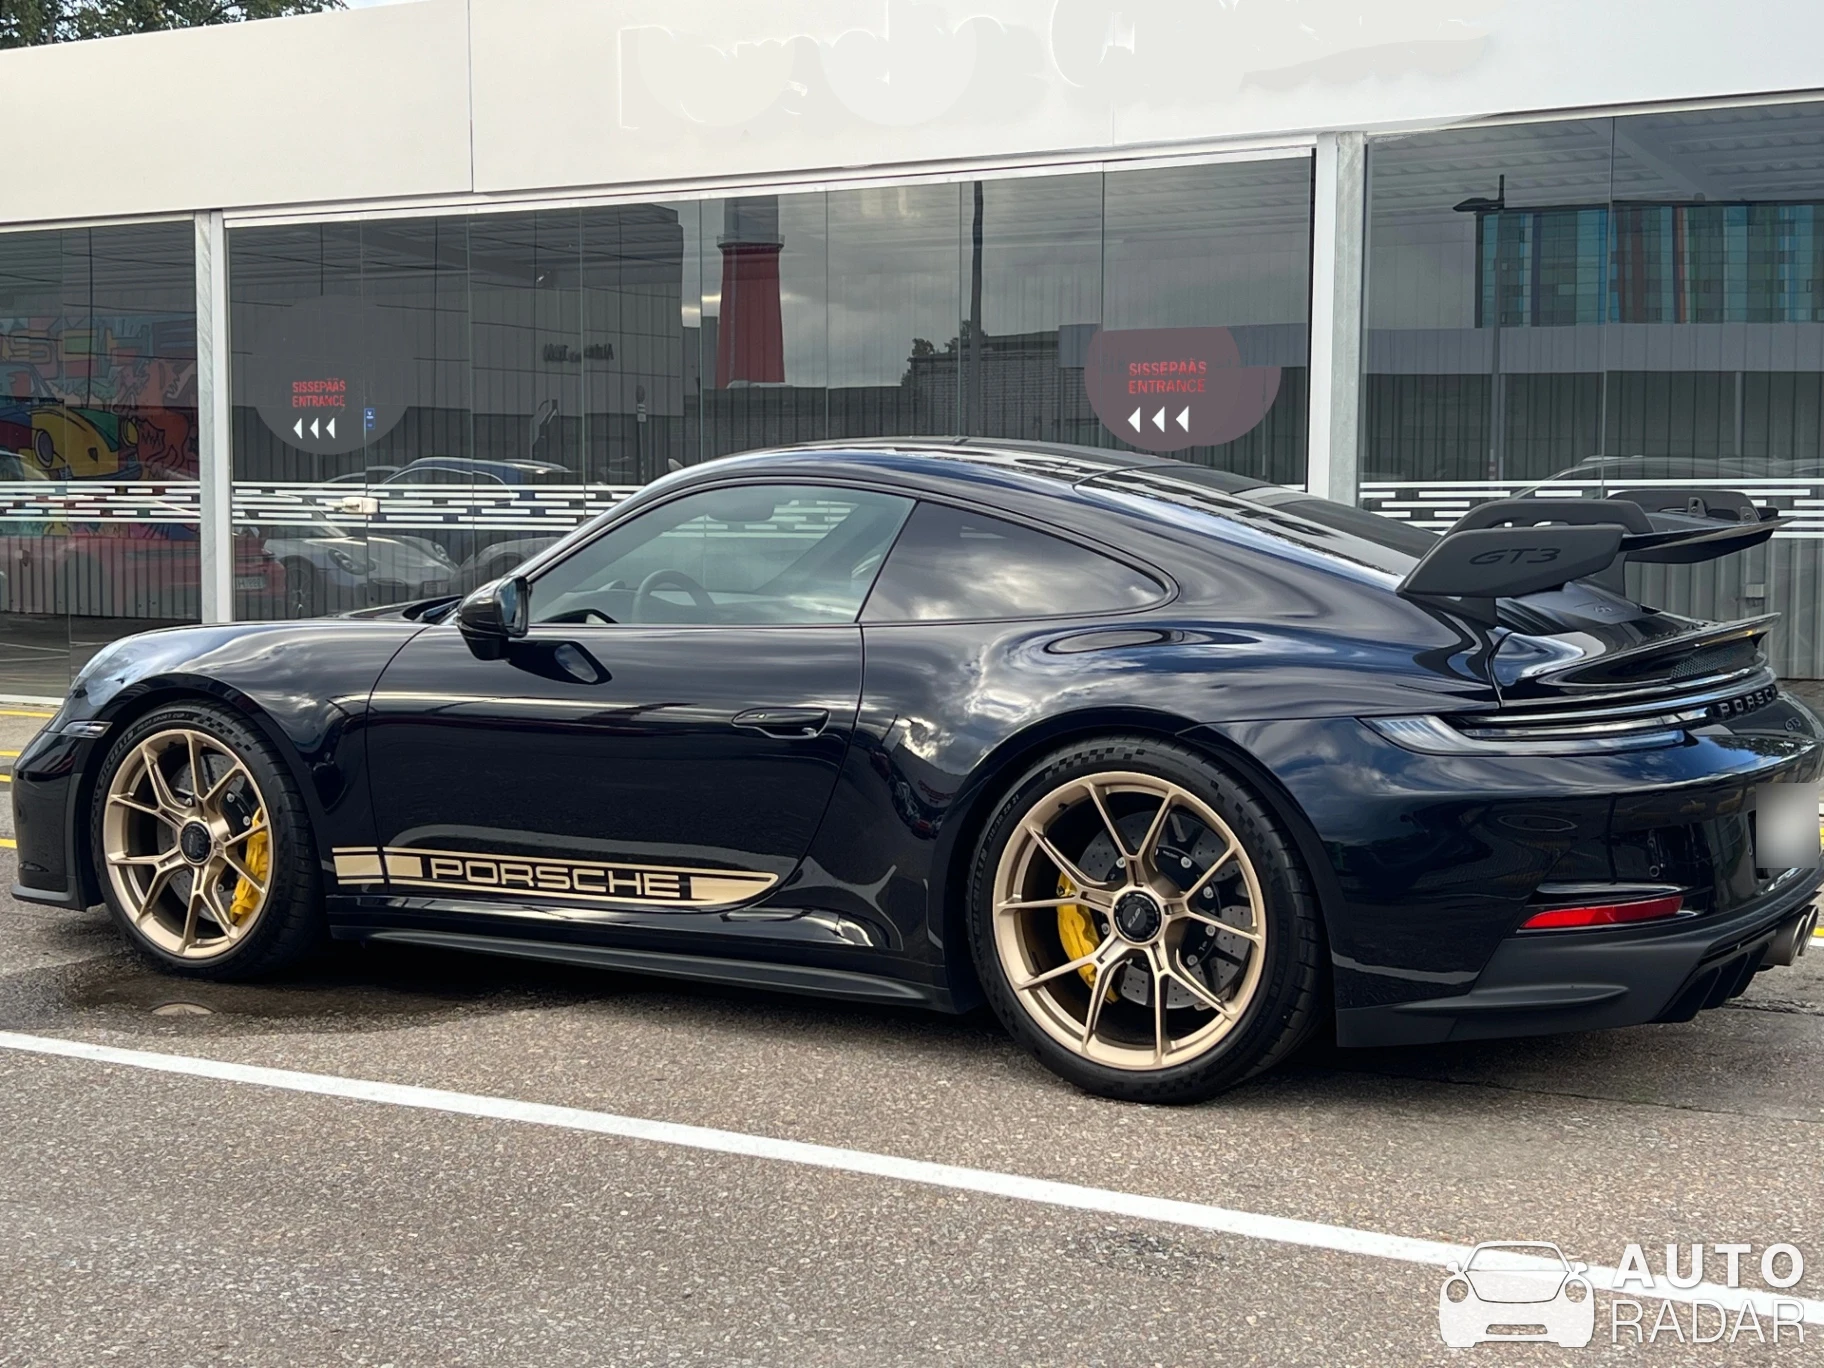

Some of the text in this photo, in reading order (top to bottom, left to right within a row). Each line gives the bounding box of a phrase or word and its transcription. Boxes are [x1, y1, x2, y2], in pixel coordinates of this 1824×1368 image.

[1128, 379, 1207, 394] ENTRANCE
[292, 395, 346, 407] ENTRANCE
[1469, 548, 1561, 565] GT3
[430, 857, 681, 898] PORSCHE
